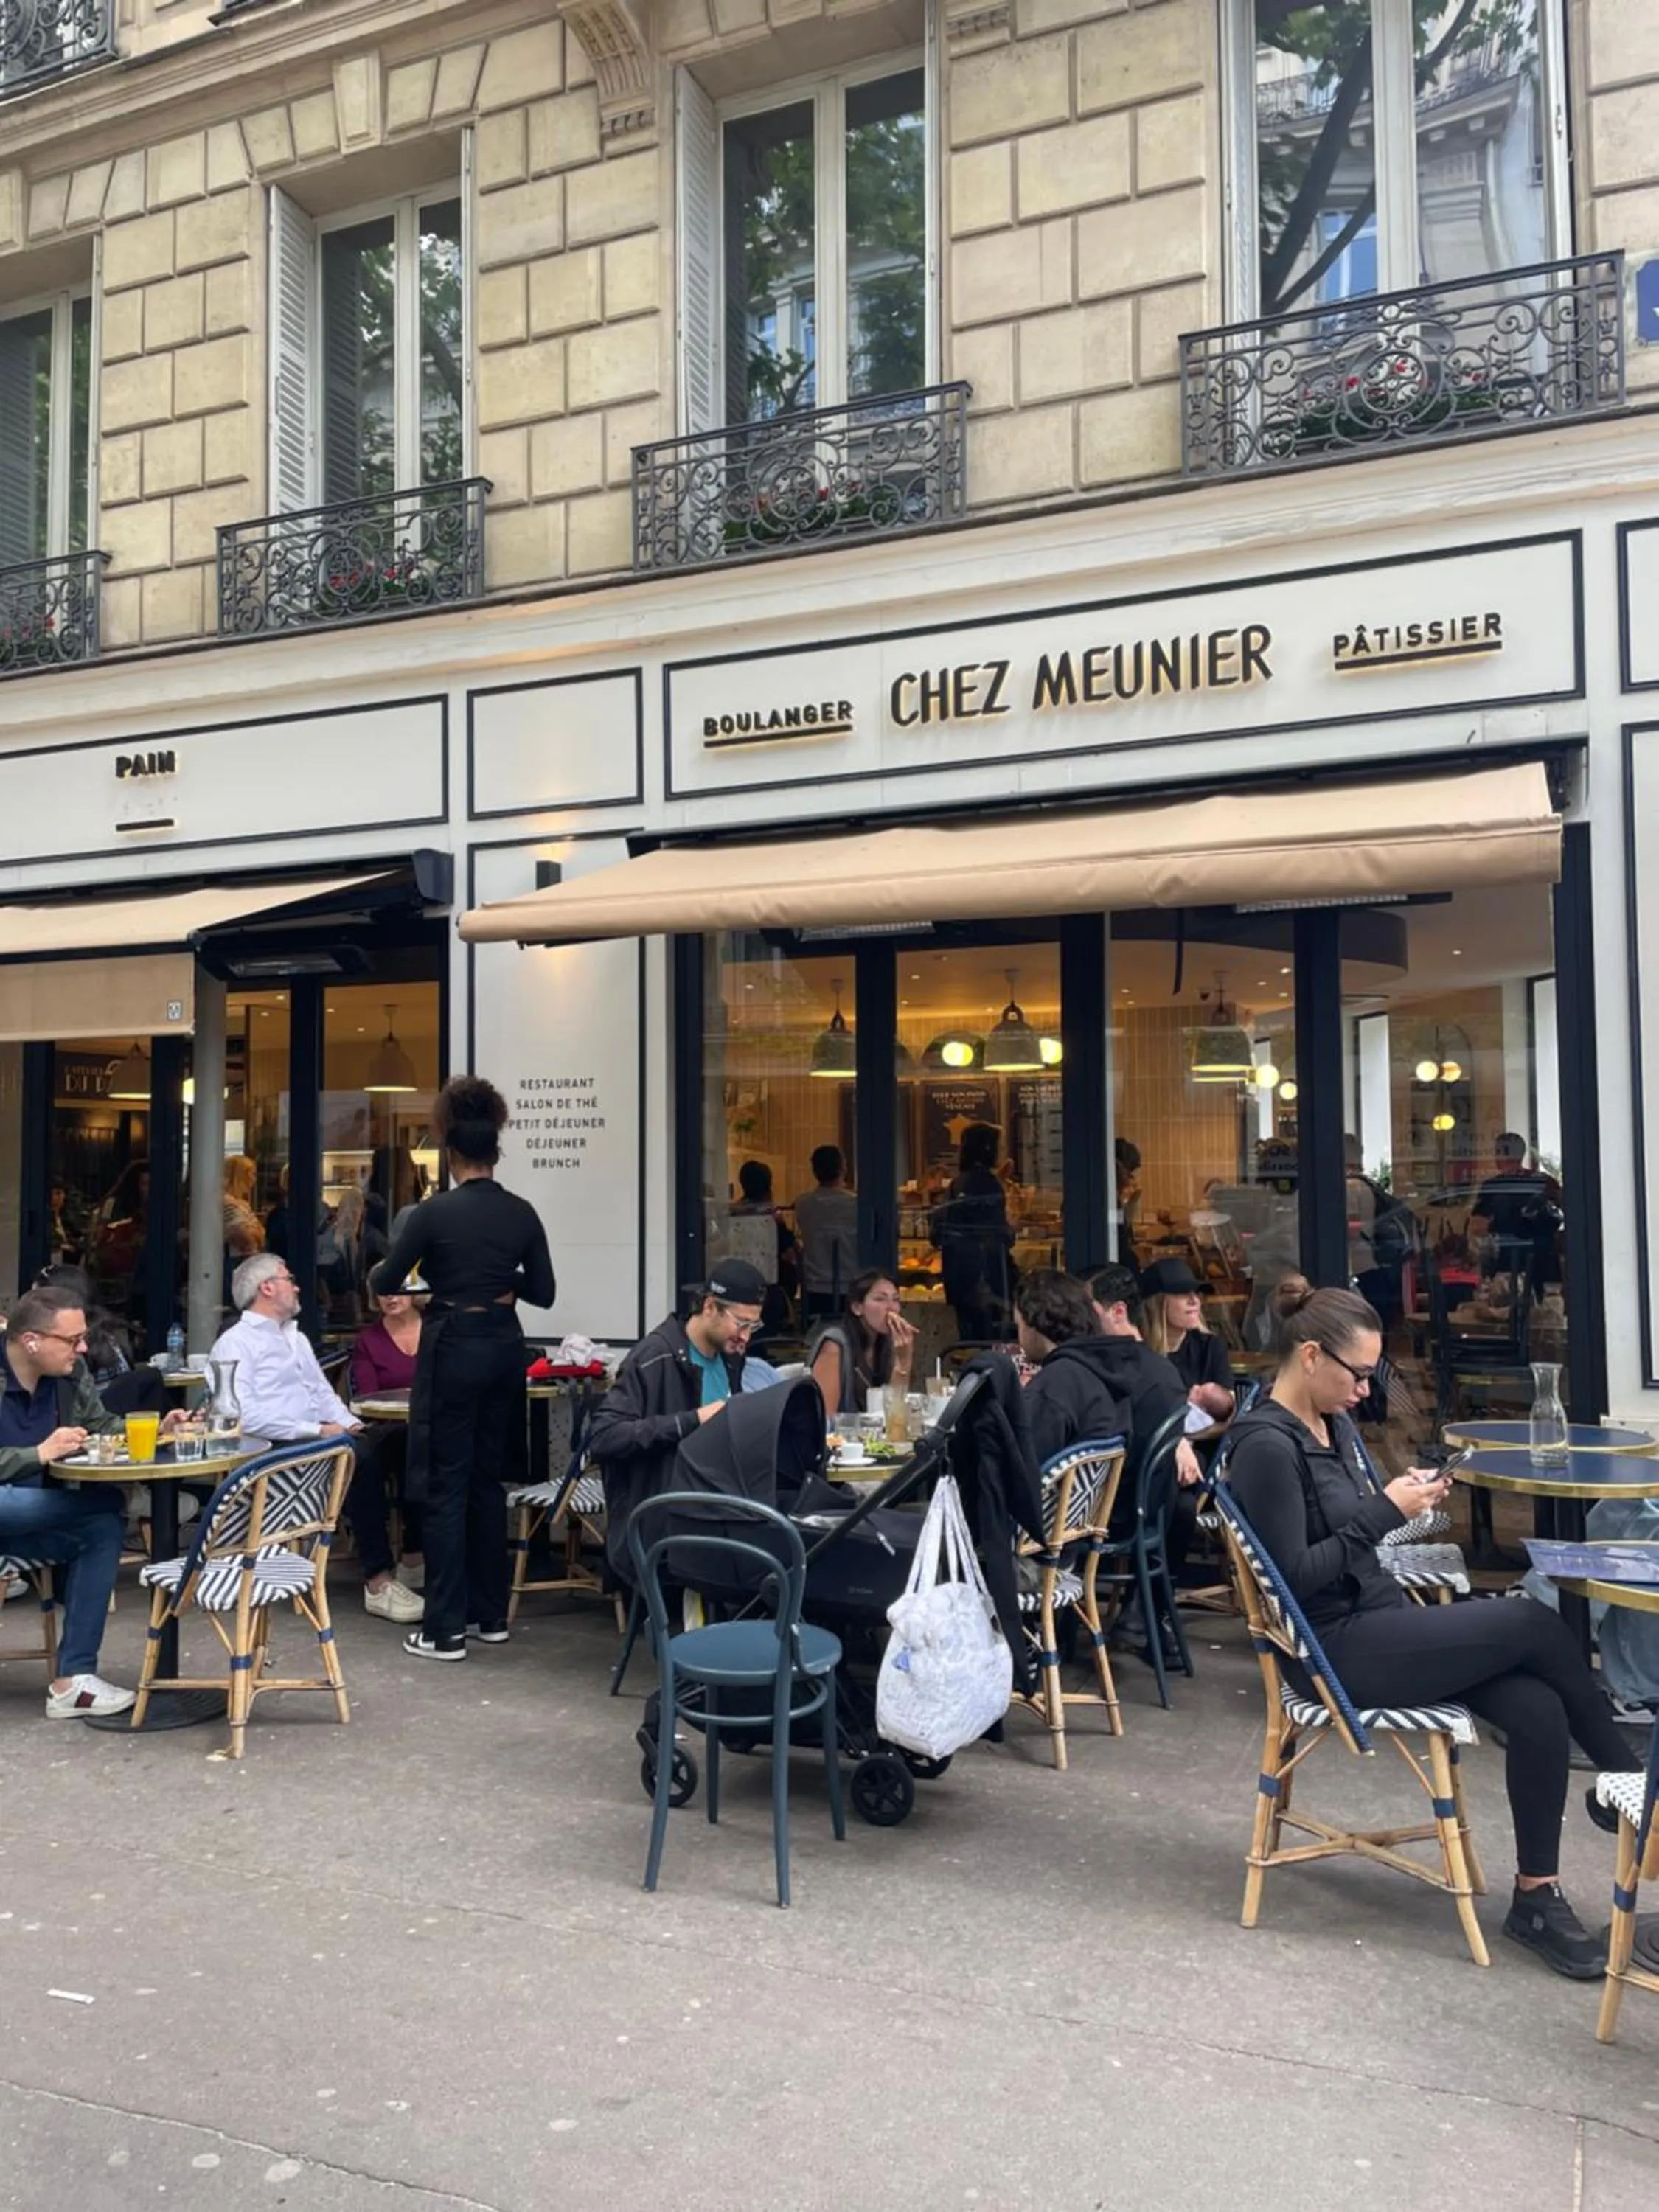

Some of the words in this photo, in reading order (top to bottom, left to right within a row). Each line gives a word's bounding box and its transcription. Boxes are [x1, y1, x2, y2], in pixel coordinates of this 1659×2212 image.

[1333, 612, 1502, 658] PÂTISSIER
[890, 659, 1011, 727] CHEZ
[1032, 624, 1273, 711] MEUNIER
[703, 700, 853, 737] BOULANGER
[115, 749, 176, 779] PAIN
[519, 1077, 596, 1091] RESTAURANT
[515, 1099, 553, 1110] SALON
[557, 1098, 571, 1110] DE
[576, 1096, 598, 1109] THÉ
[508, 1119, 541, 1130] PETIT
[544, 1116, 606, 1130] DÉJEUNER
[526, 1137, 588, 1150] DÉJEUNER
[532, 1158, 580, 1169] BRUNCH
